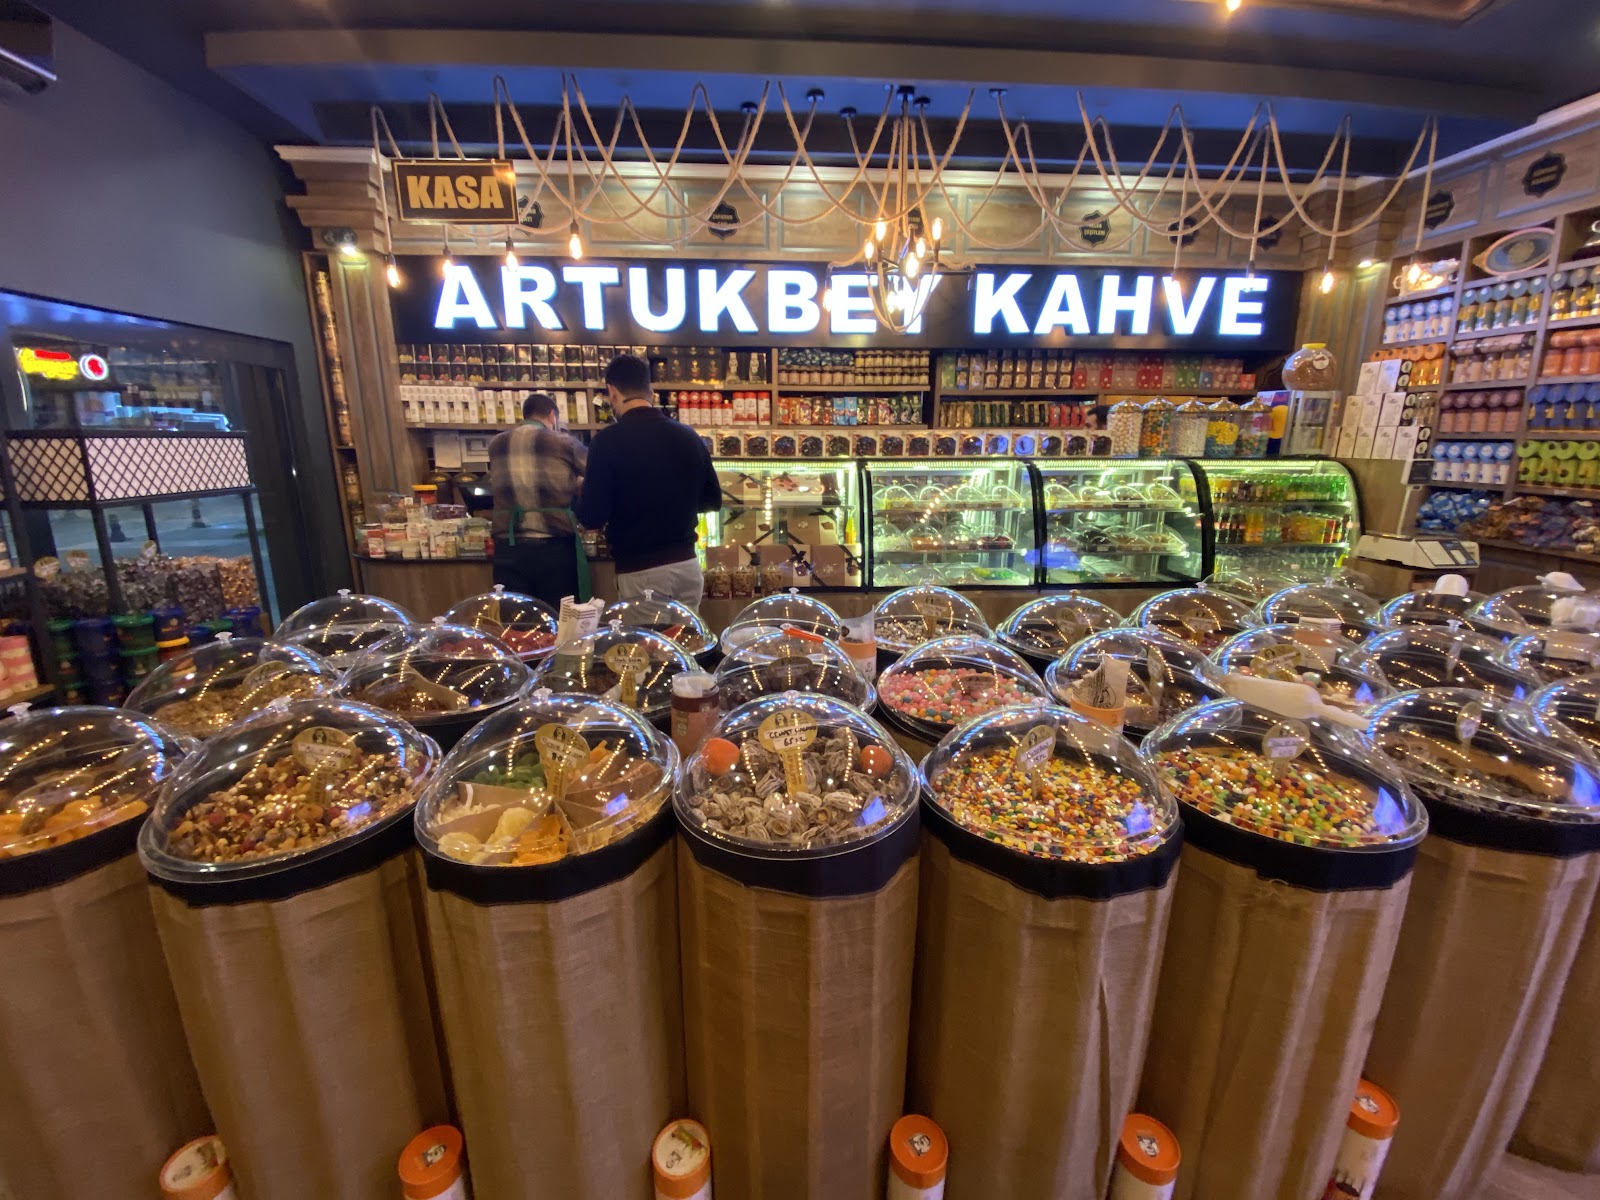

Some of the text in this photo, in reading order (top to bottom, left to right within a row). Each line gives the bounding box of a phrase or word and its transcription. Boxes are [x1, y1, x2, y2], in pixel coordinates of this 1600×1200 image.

[406, 175, 505, 210] KASA
[434, 264, 1269, 335] ARTUKBEY KAHVE
